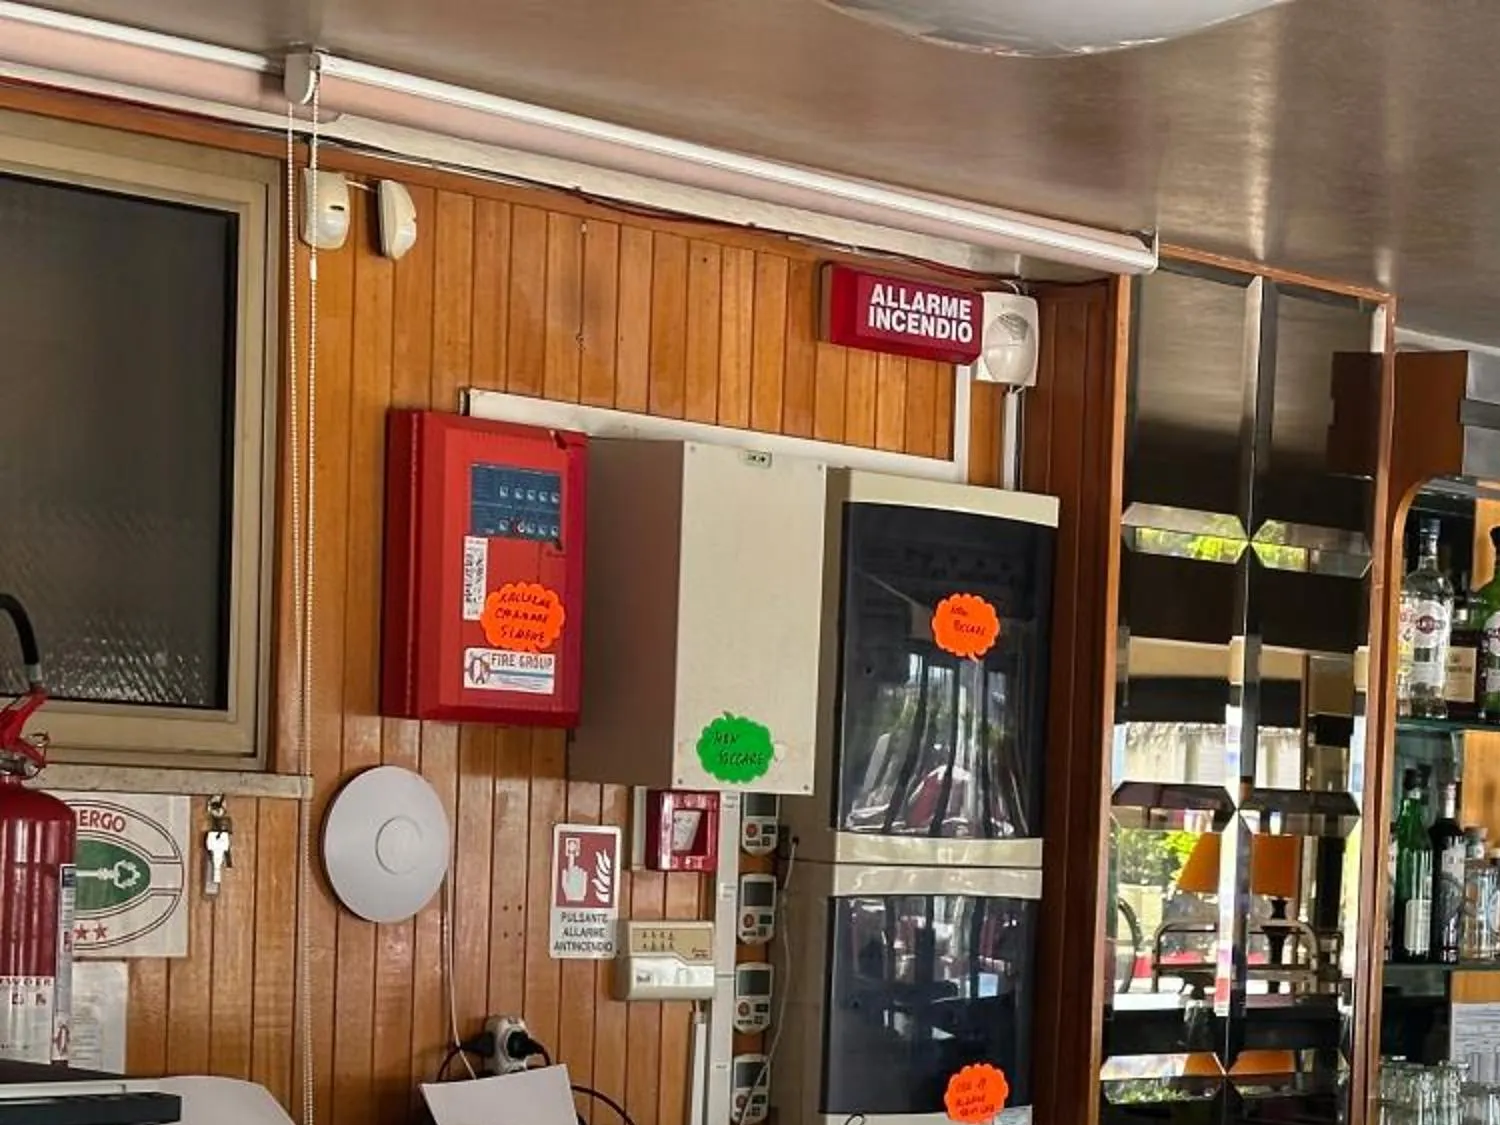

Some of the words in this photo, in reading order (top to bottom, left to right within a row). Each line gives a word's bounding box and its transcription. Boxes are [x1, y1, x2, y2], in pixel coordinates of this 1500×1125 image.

[871, 283, 972, 321] ALLARME
[868, 305, 973, 343] INCENDIO
[491, 653, 517, 667] FIRE
[519, 655, 554, 670] GROUP
[560, 911, 609, 924] PULSANTE
[563, 927, 606, 937] ALLARME
[553, 941, 614, 952] ANTINCENDIO
